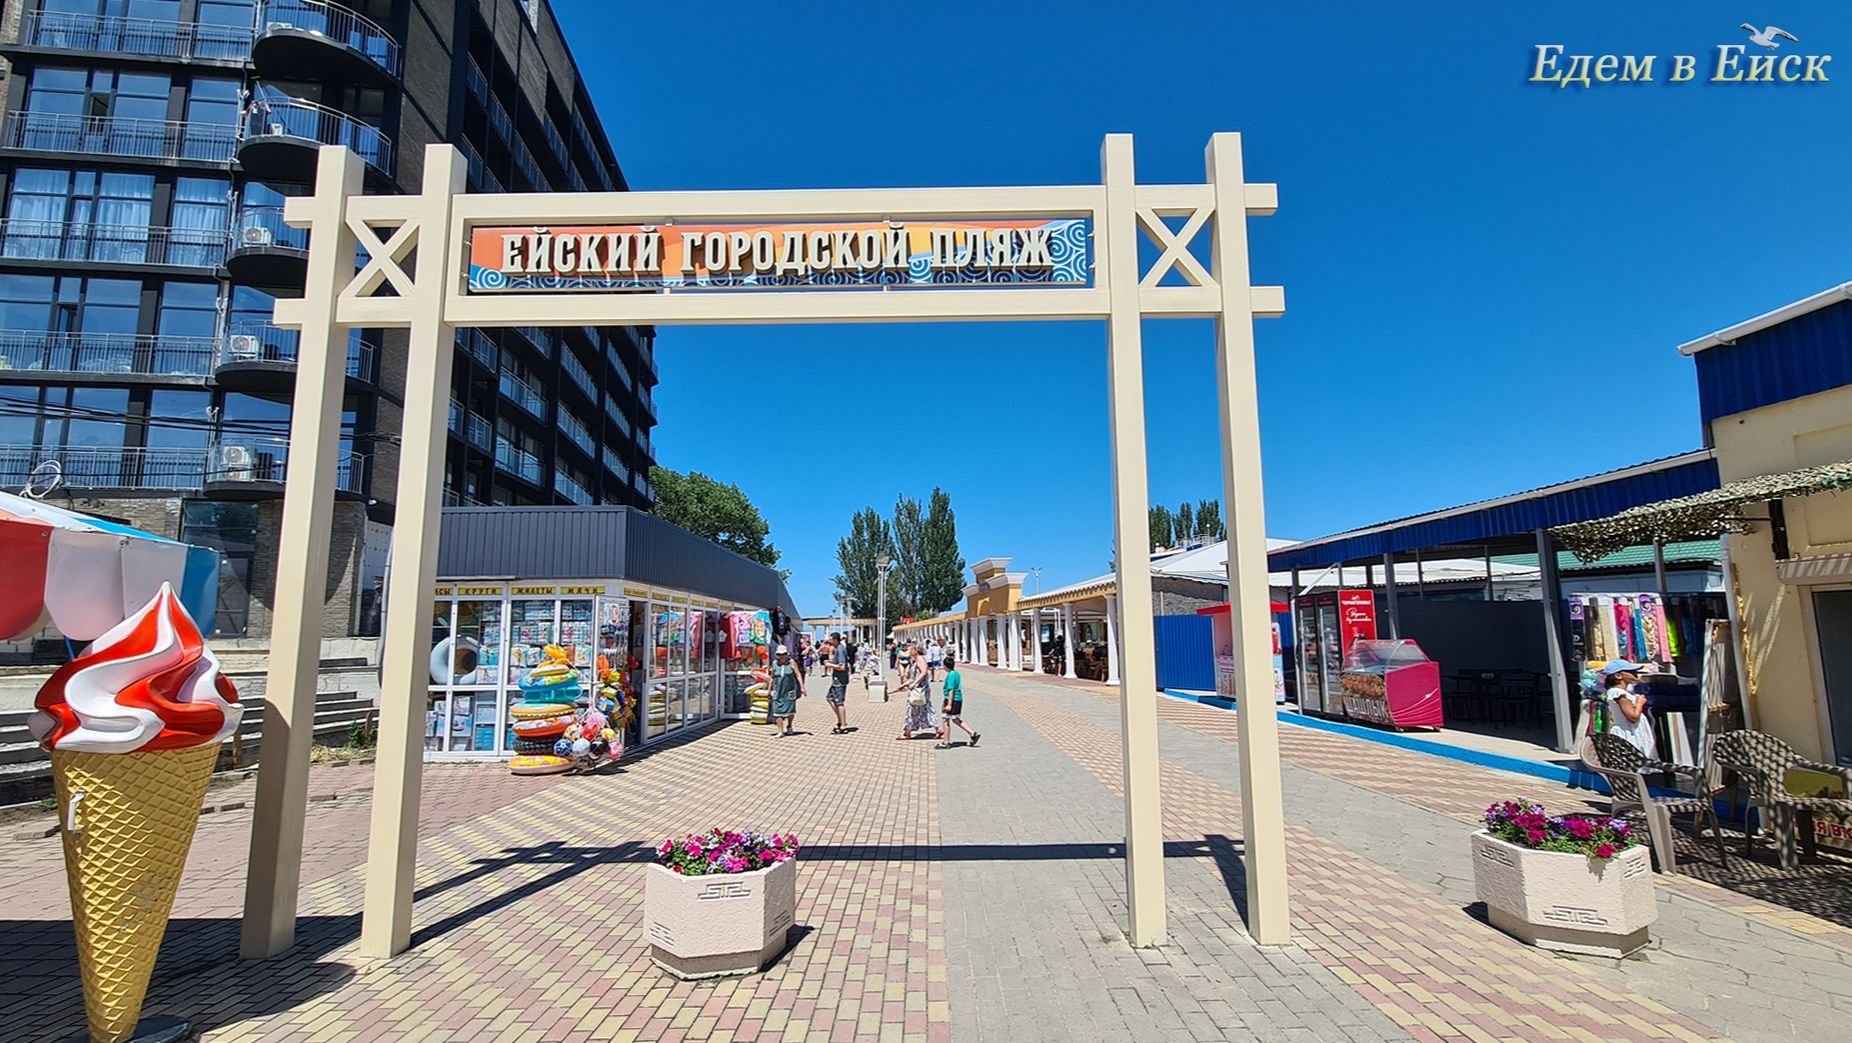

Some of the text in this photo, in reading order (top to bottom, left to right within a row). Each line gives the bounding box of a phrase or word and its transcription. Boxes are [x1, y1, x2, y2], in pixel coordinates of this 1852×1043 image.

[501, 222, 1052, 276] ЕЙСКИЙ ГОРОДСКОЙ ПЛЯЖ
[1344, 696, 1389, 719] ШАШЛЫК
